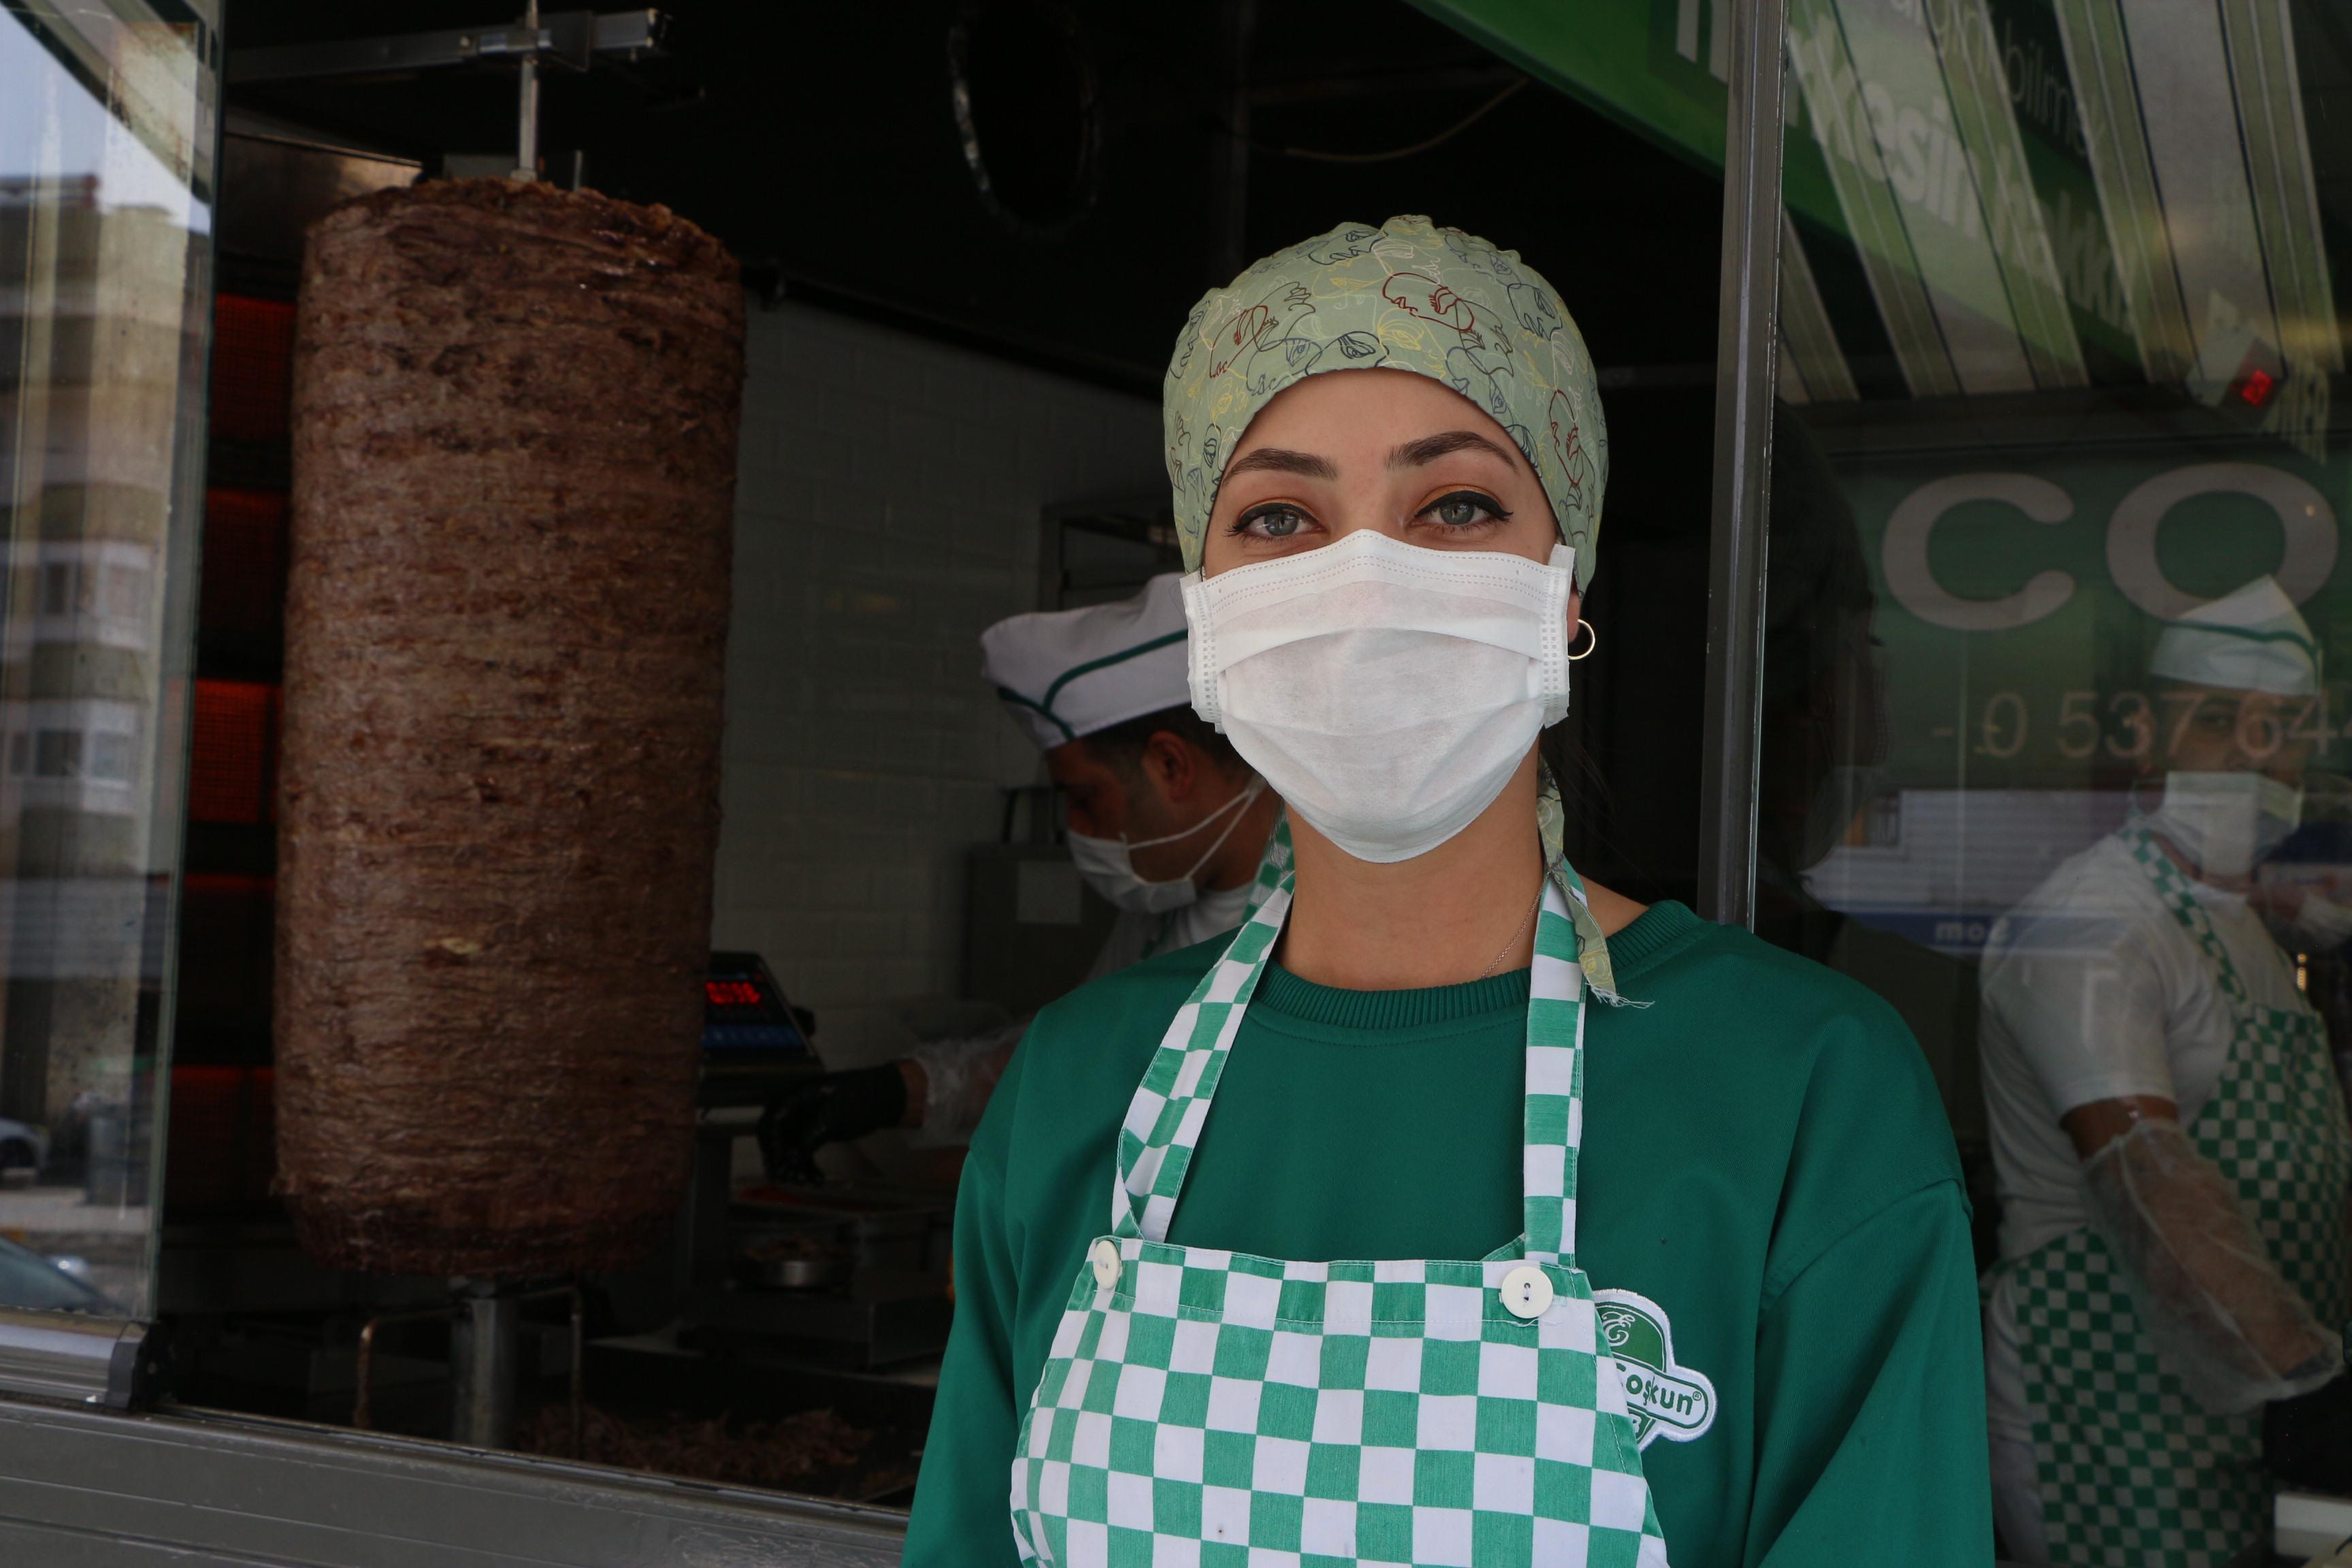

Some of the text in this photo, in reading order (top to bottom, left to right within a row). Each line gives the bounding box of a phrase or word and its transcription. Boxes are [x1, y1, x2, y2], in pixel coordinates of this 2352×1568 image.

[1881, 462, 2339, 630] CO
[2234, 690, 2352, 758] 64
[1616, 1362, 1693, 1416] oşkun
